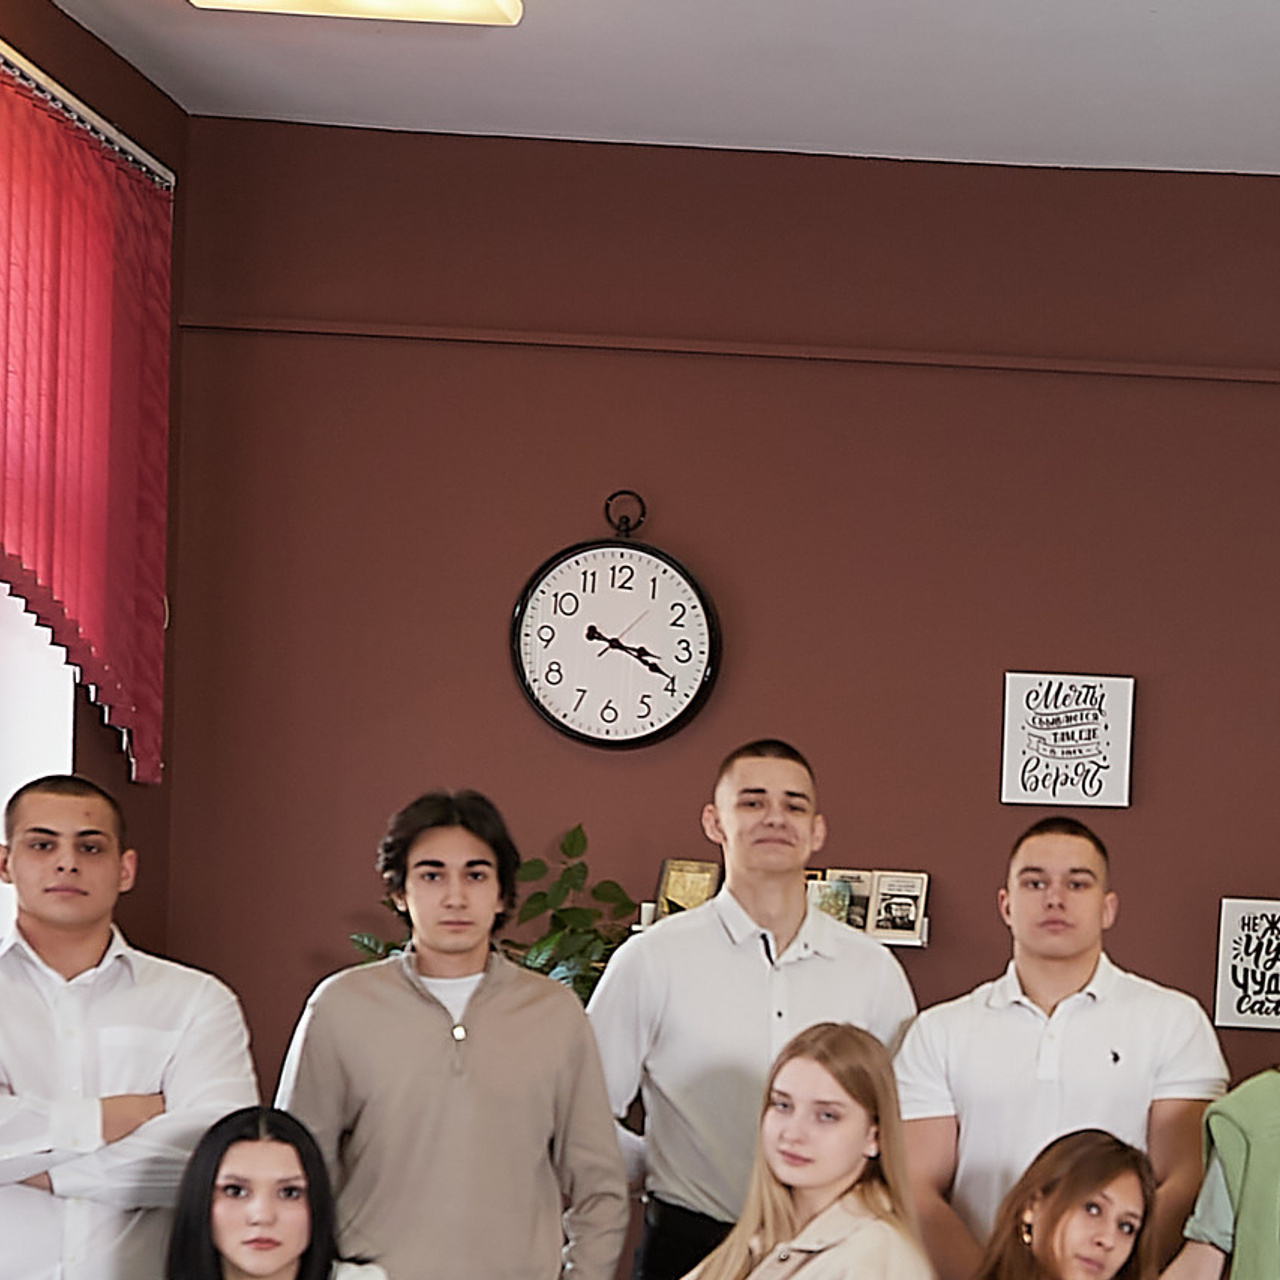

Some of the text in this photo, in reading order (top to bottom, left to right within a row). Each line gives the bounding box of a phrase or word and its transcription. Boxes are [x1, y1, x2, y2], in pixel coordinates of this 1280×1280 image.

[581, 570, 597, 593] 11
[609, 565, 635, 590] 12
[649, 576, 658, 600] 1
[552, 592, 579, 616] 10
[669, 602, 687, 628] 2
[537, 624, 556, 649] 9
[674, 639, 692, 664] 3
[544, 661, 563, 685] 8
[663, 675, 678, 698] 4
[574, 688, 588, 712] 7
[600, 699, 619, 723] 6
[636, 694, 653, 718] 5
[1241, 915, 1259, 932] НЕ
